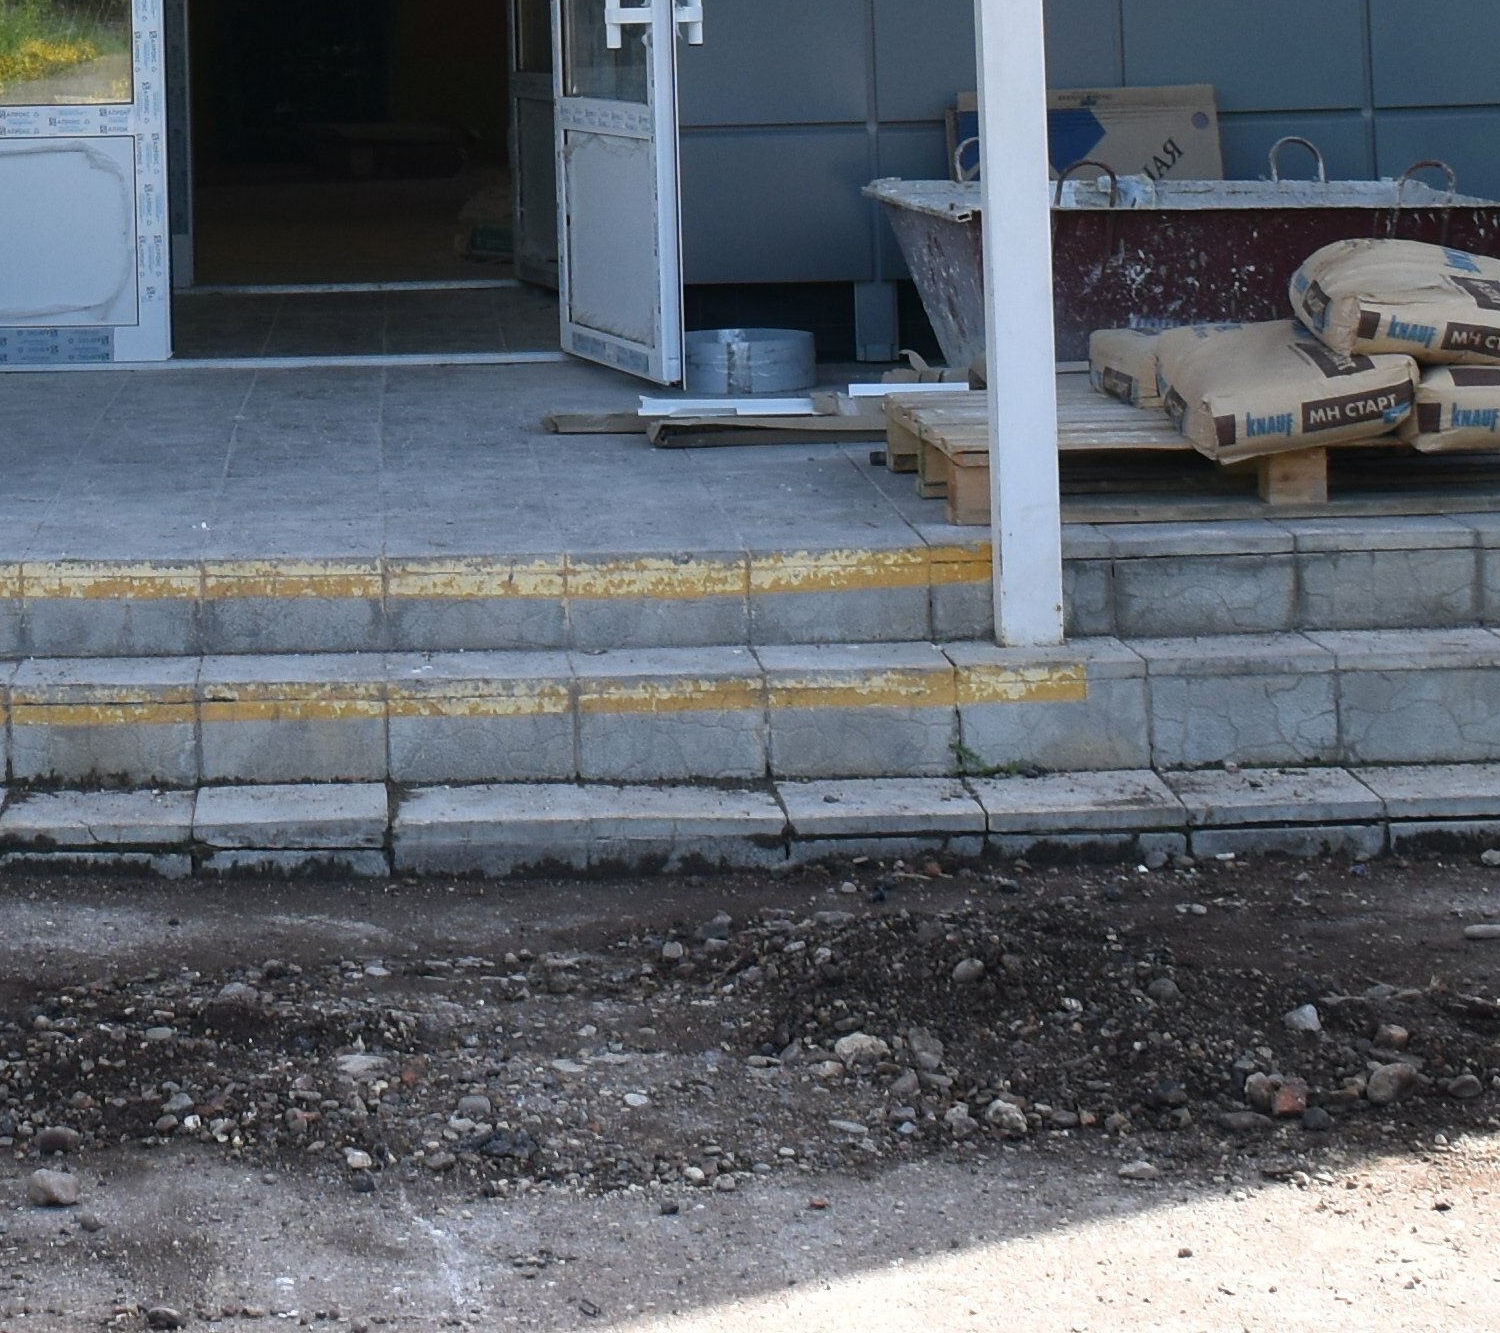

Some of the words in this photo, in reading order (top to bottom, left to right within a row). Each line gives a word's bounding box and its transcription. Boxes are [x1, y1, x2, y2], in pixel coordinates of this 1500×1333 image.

[1387, 315, 1437, 349] KNAUF
[1451, 330, 1482, 347] МН
[1309, 406, 1340, 424] МН
[1345, 393, 1398, 418] СТАРТ
[1451, 402, 1500, 431] KNAUF
[1246, 412, 1294, 437] KNAUF
